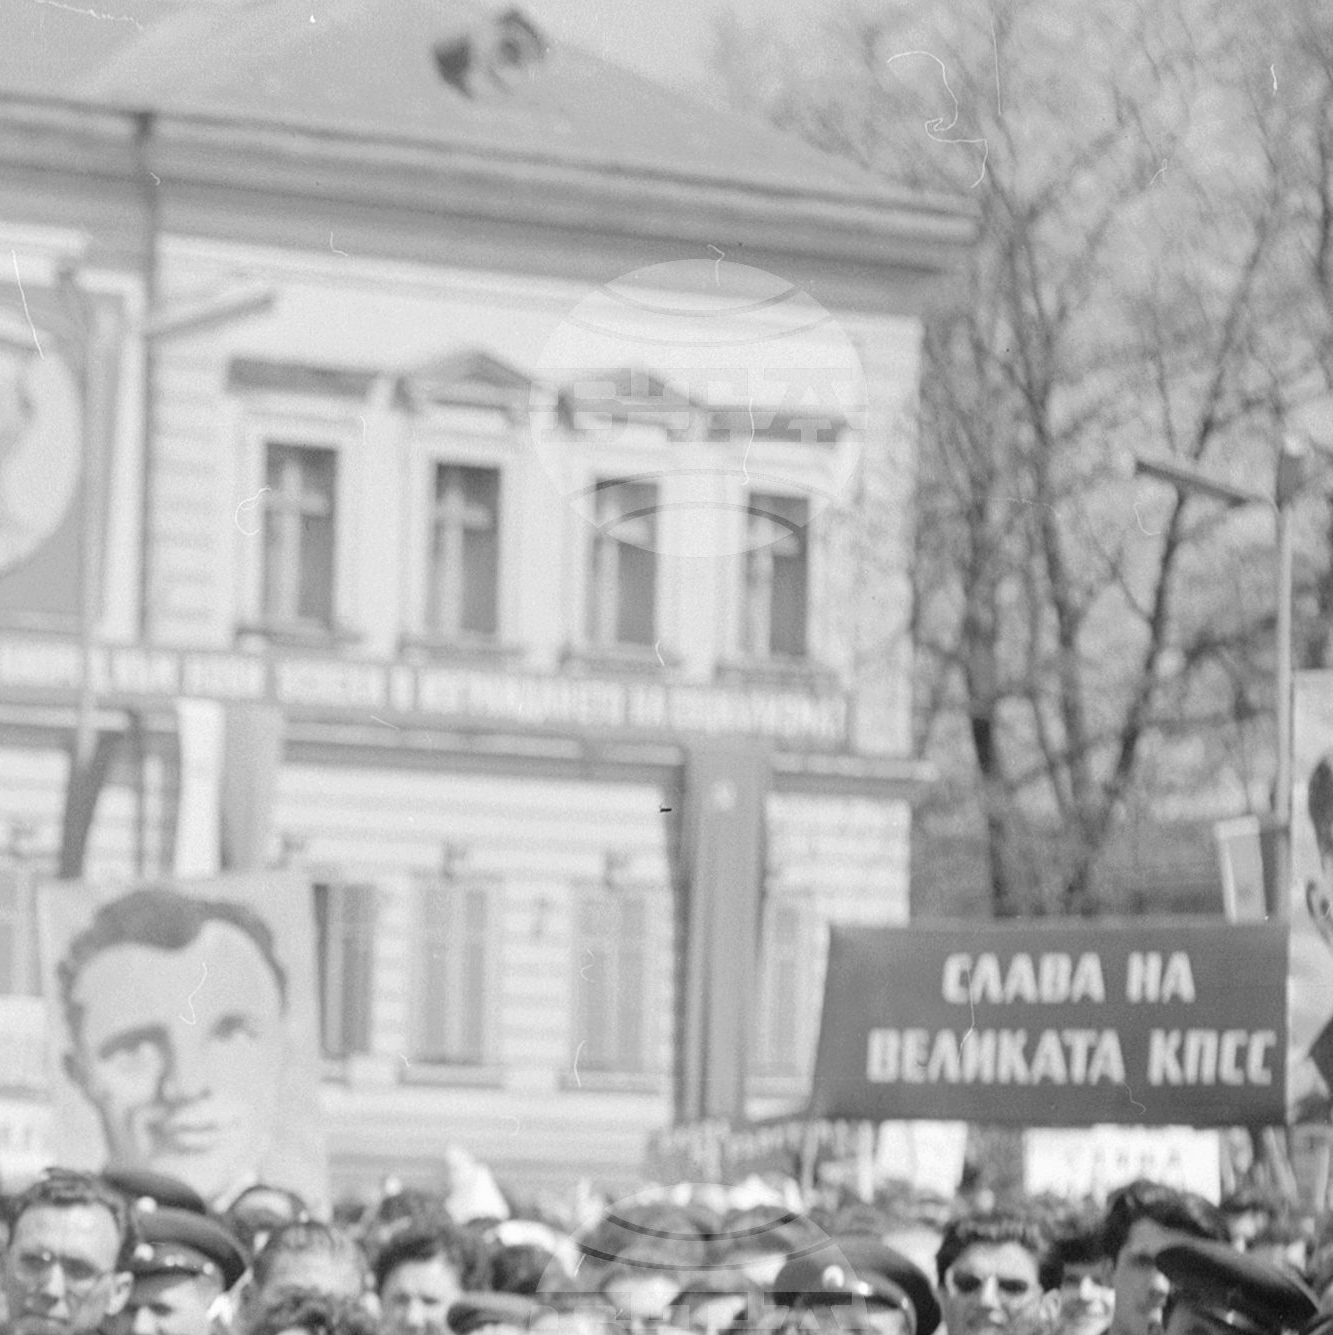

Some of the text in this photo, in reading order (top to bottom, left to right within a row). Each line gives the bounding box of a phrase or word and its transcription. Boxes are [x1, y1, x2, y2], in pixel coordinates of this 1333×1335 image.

[941, 951, 1195, 1005] СЛАВА НА
[865, 1027, 1276, 1086] ВЕЛИКАТА КПСС
